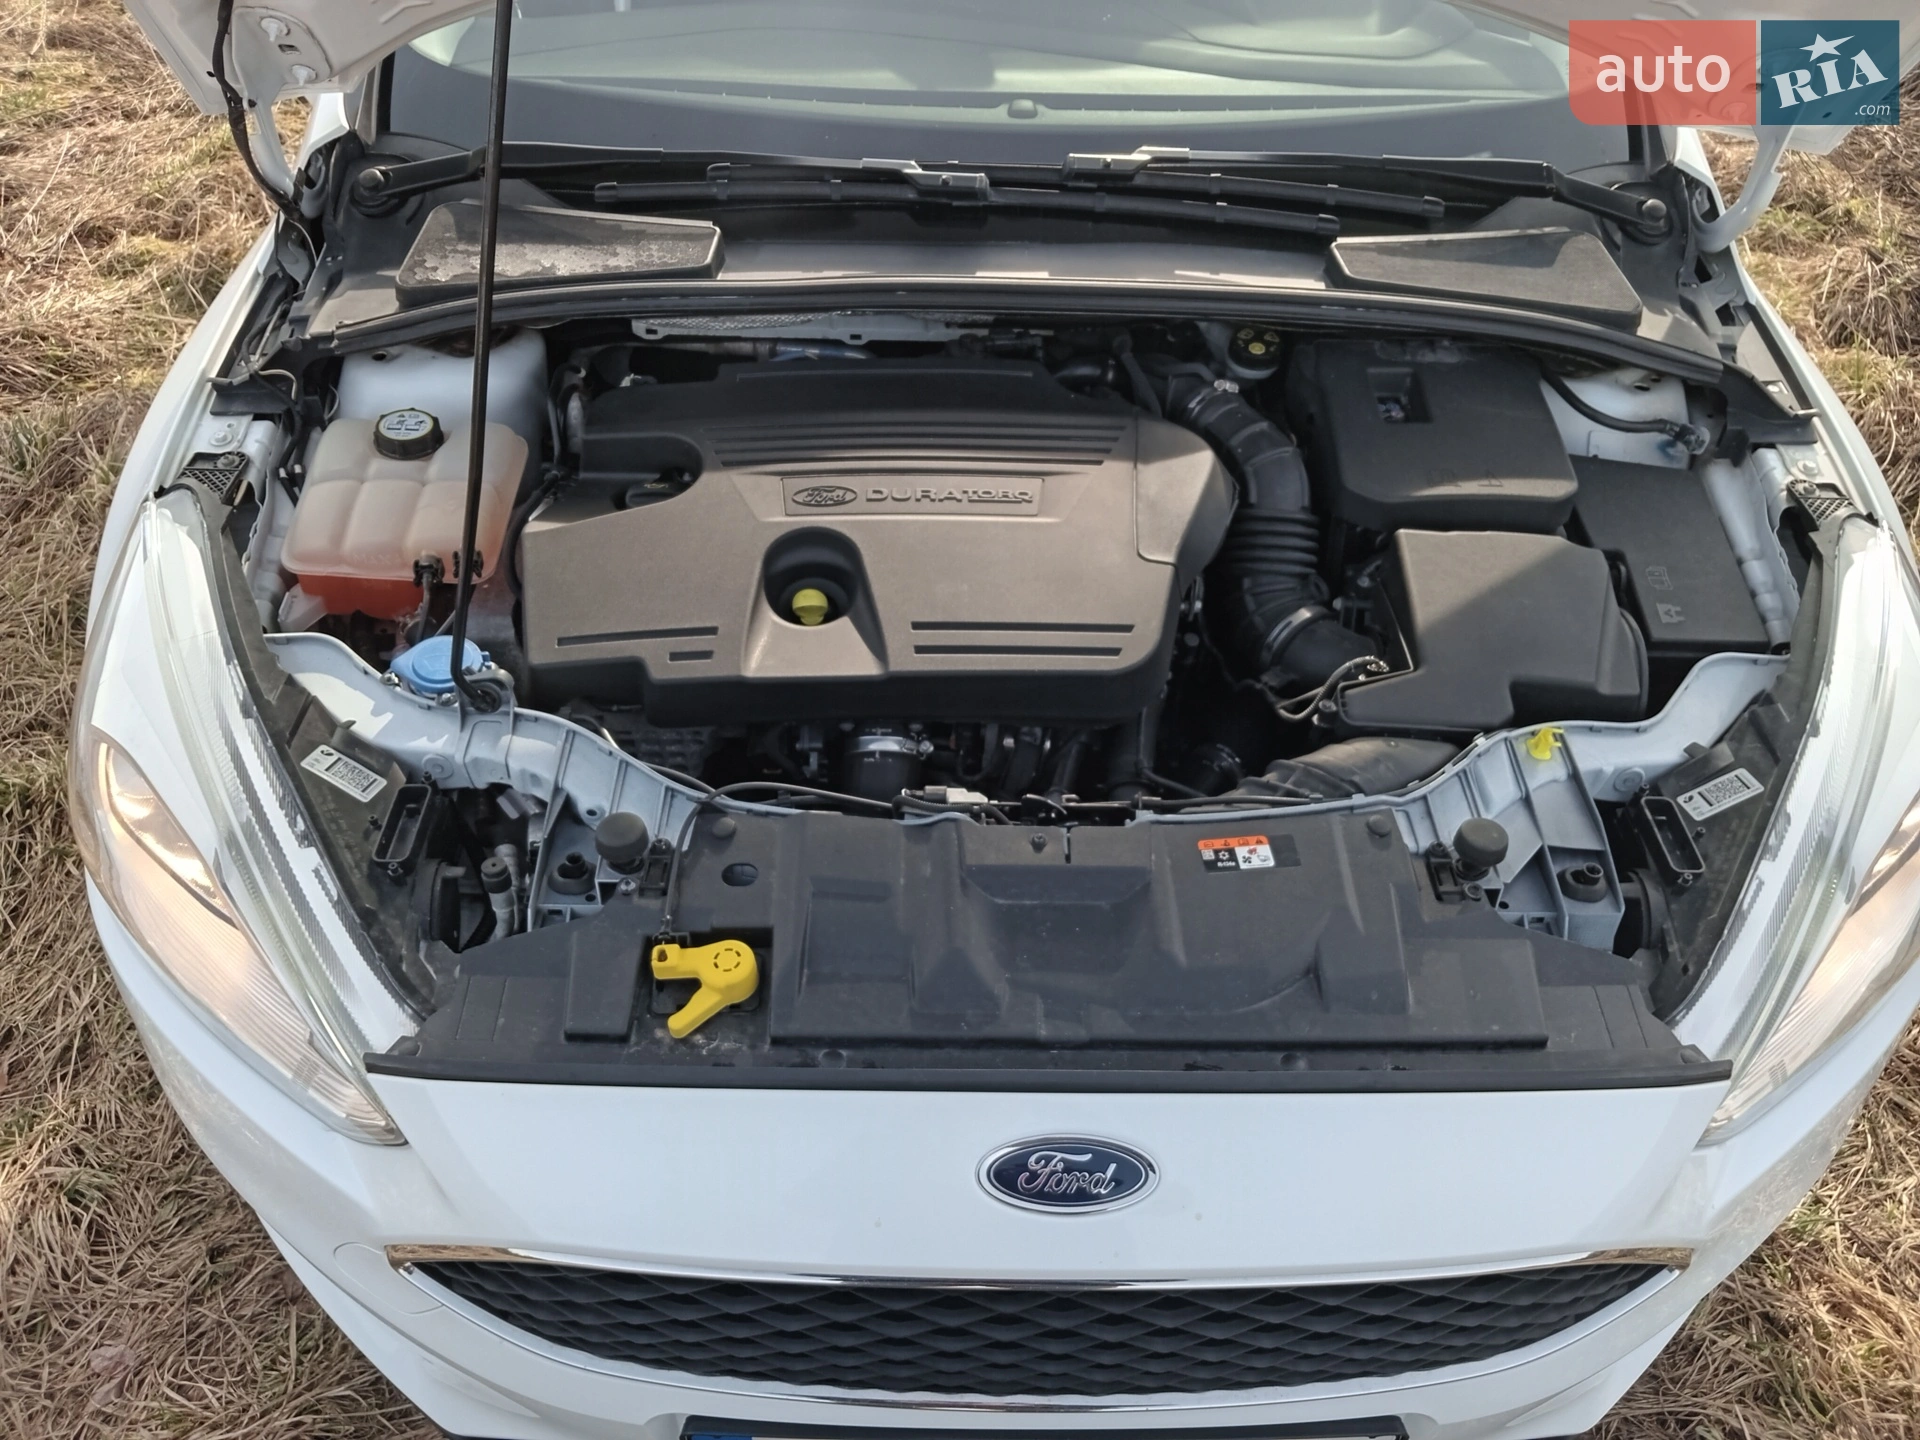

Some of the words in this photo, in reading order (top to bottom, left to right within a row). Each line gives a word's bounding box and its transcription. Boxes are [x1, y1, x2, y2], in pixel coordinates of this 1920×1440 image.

[801, 486, 849, 505] Ford
[865, 487, 1034, 504] DURATORQ
[1017, 1150, 1117, 1195] Ford
